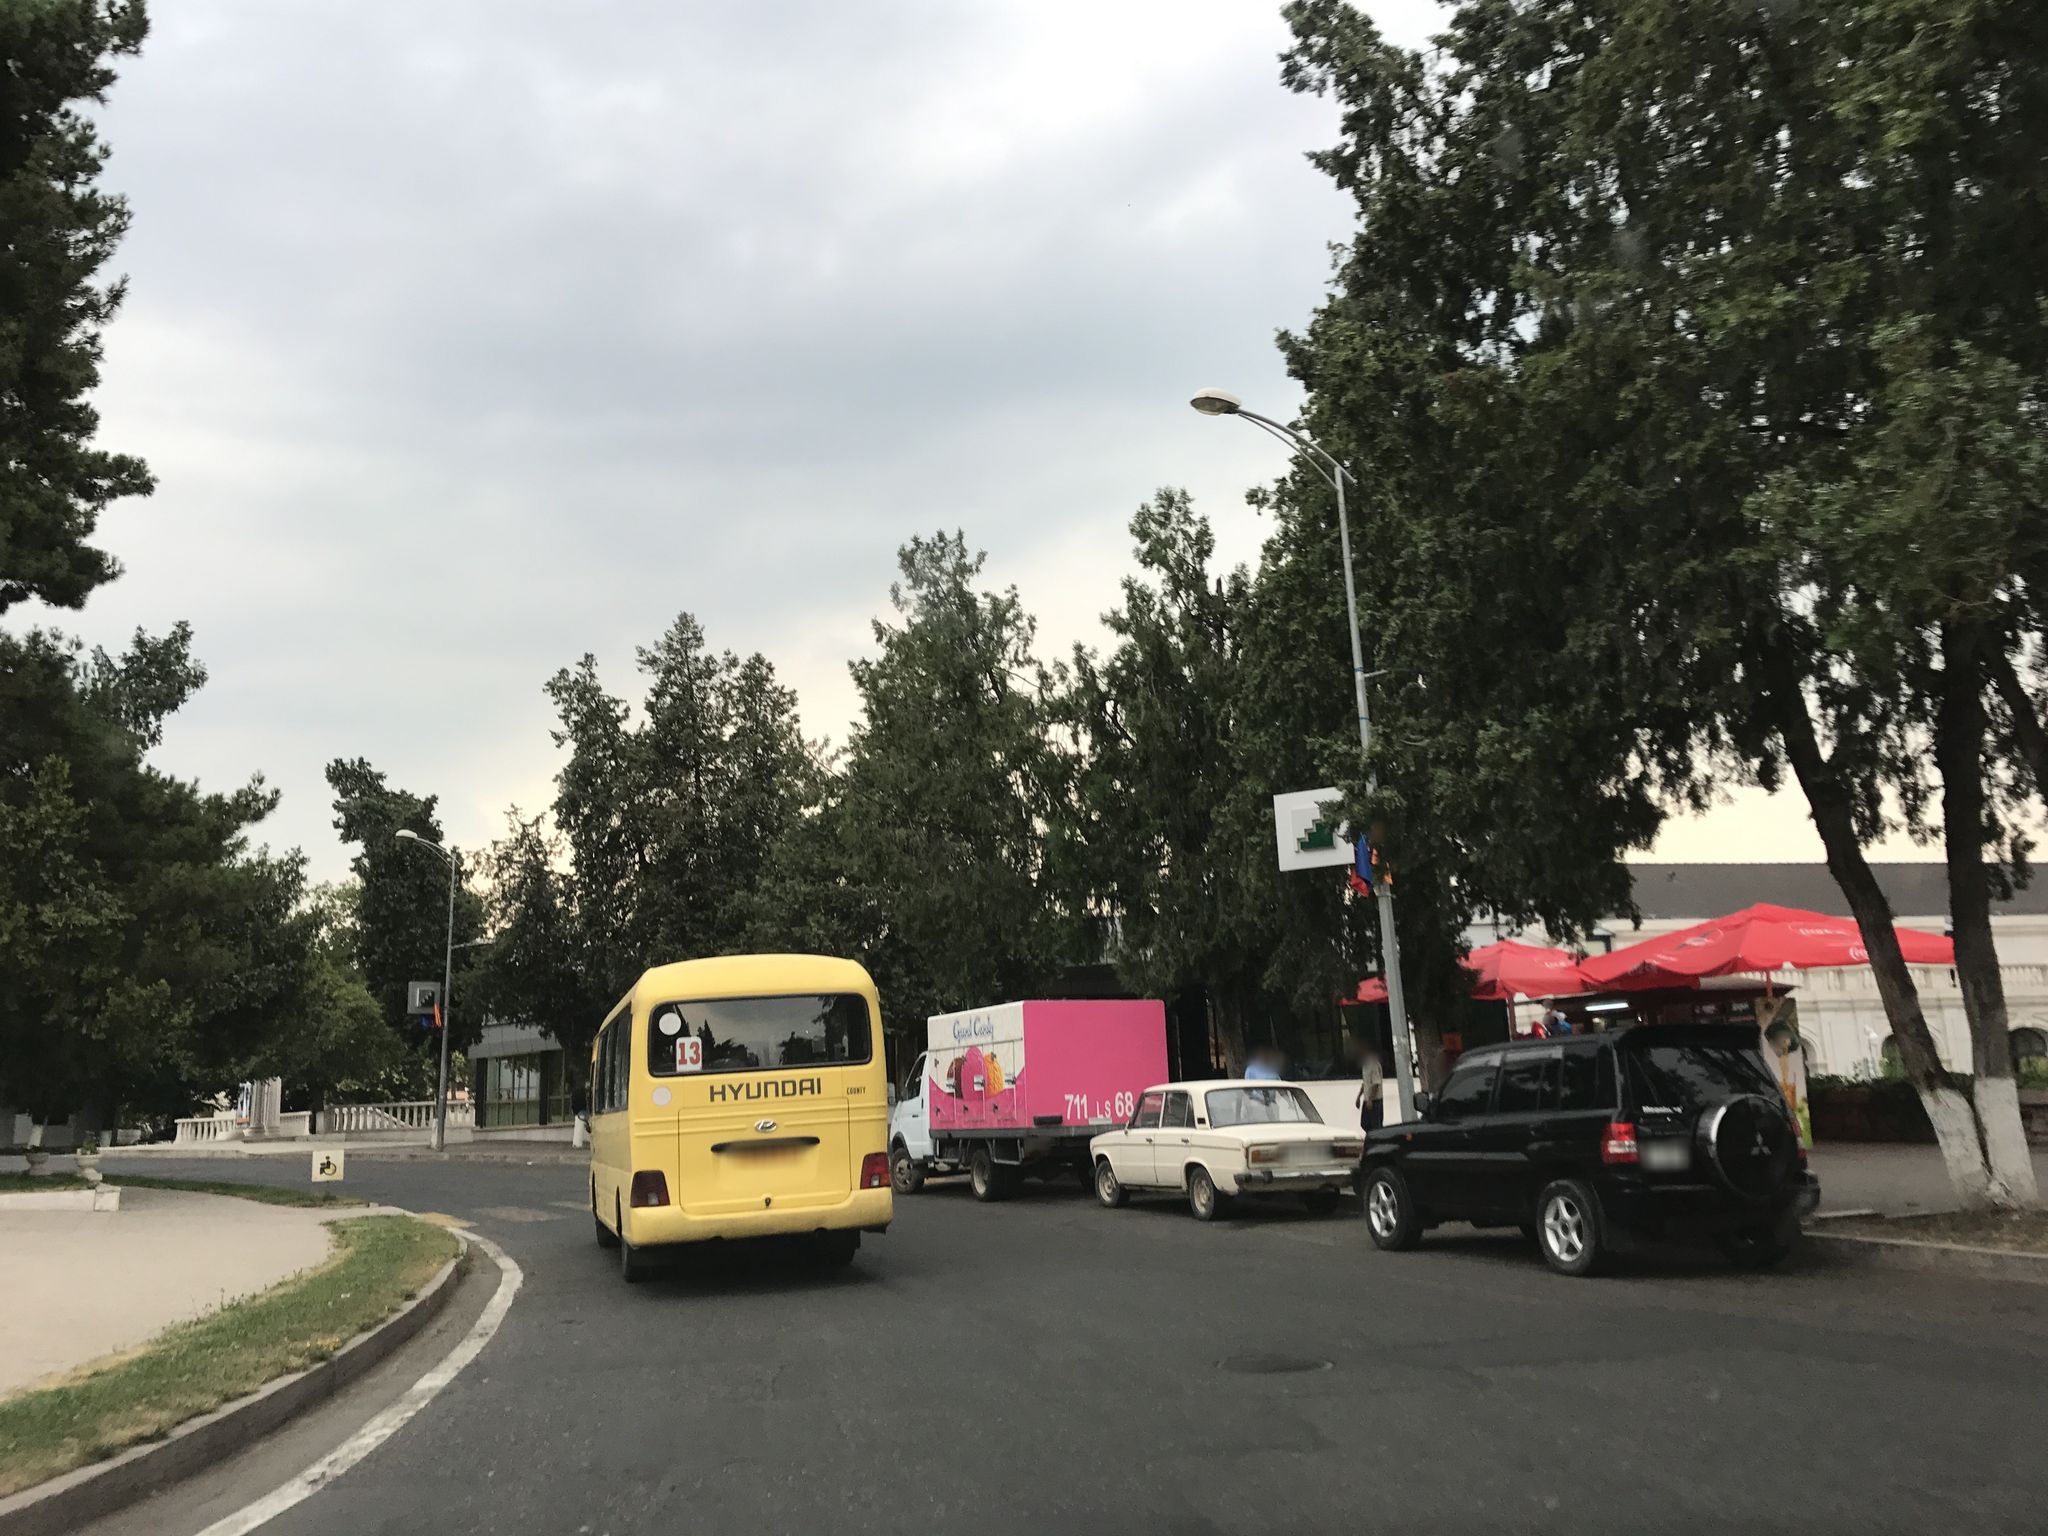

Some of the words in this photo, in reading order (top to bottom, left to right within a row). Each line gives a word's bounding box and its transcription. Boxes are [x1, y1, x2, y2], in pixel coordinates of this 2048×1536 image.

[678, 1041, 701, 1065] 13
[709, 1077, 822, 1102] HYUNDAI
[1064, 1093, 1088, 1120] 711
[1096, 1100, 1112, 1119] LS
[1114, 1090, 1135, 1118] 68
